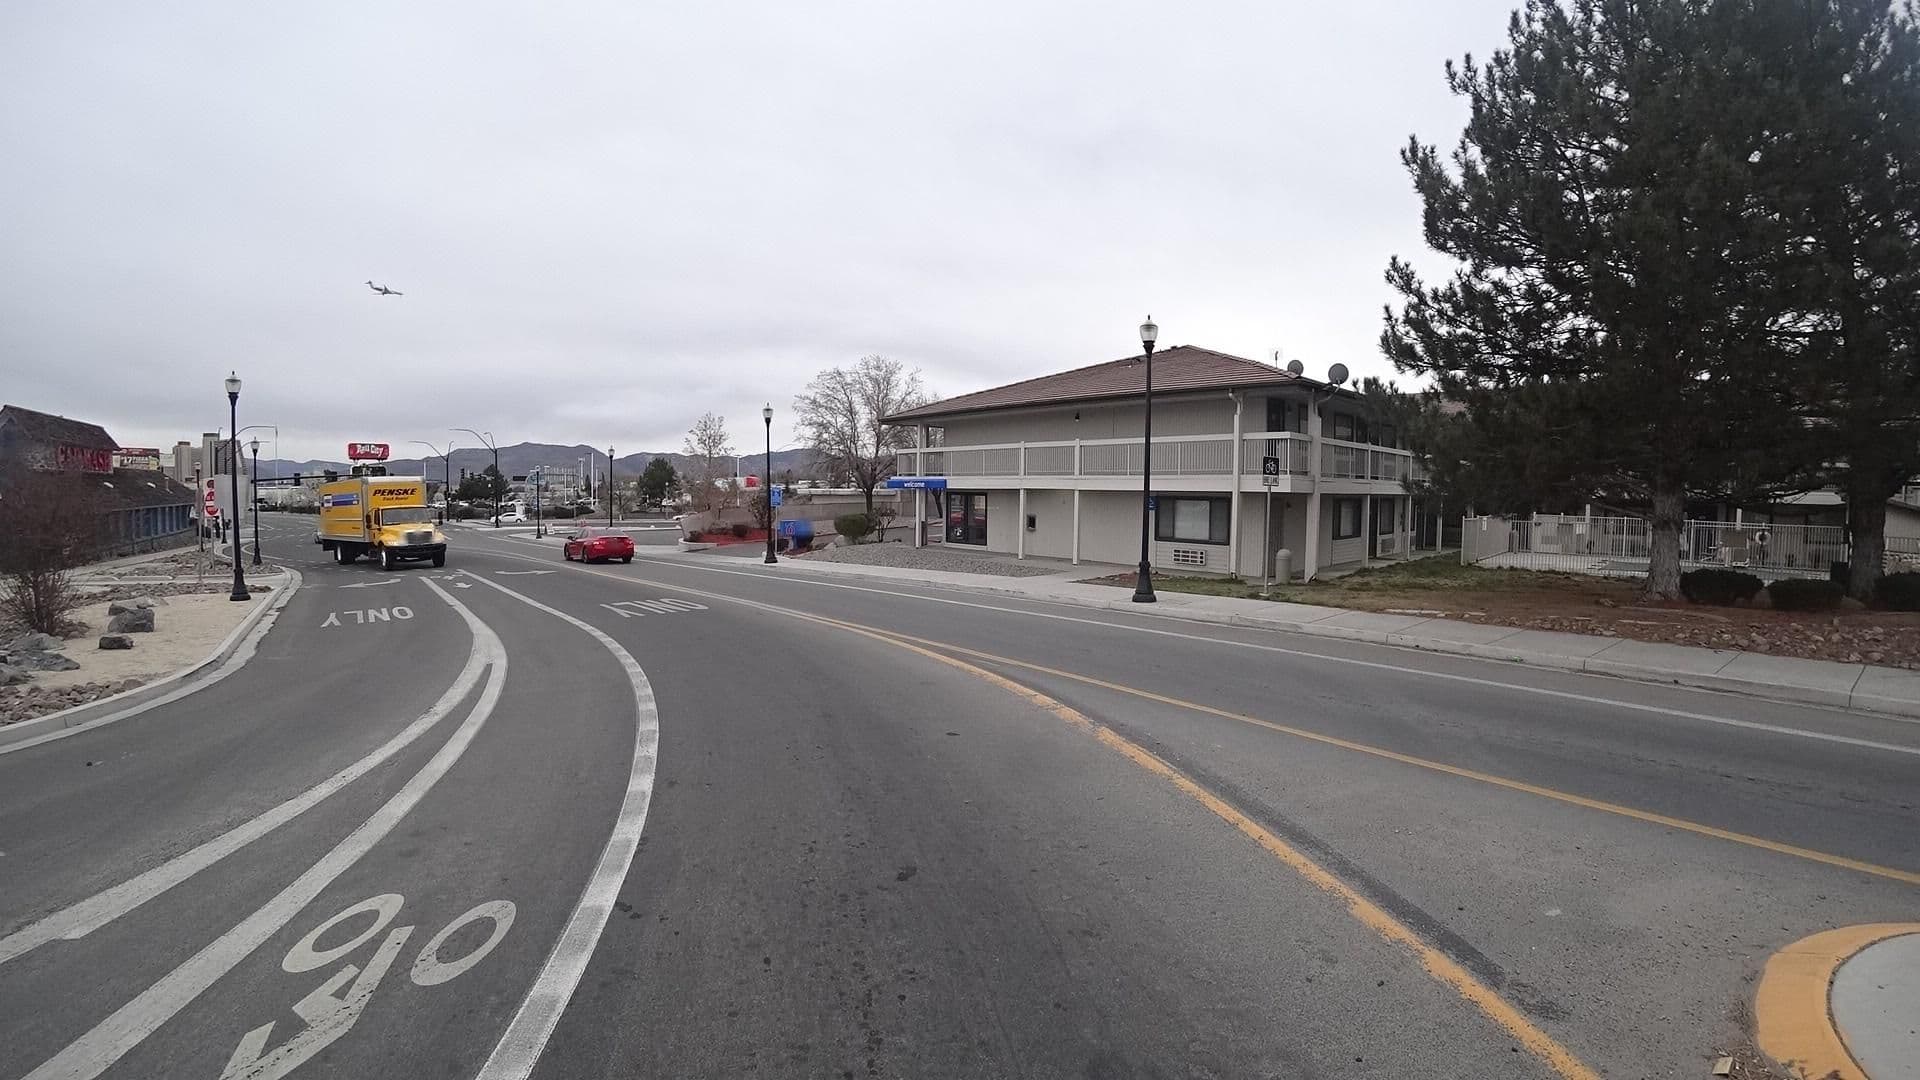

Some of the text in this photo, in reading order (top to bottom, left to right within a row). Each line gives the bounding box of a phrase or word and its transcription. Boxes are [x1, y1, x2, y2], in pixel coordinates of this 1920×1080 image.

[372, 488, 418, 496] PENSKE
[320, 606, 414, 628] ONLY
[600, 598, 709, 618] ONLY
